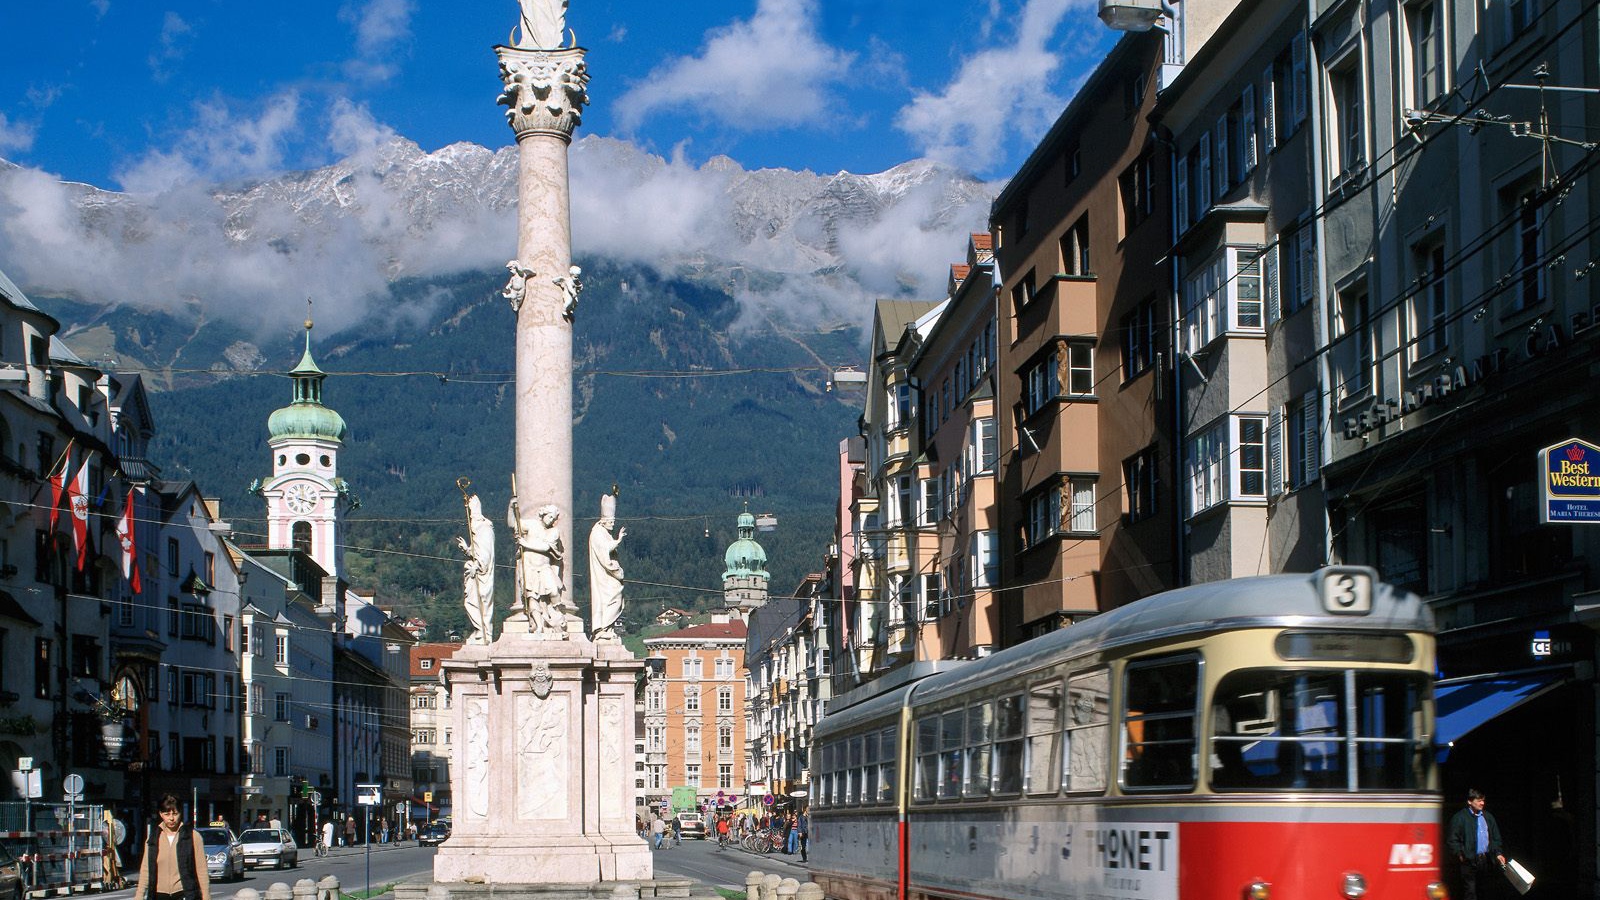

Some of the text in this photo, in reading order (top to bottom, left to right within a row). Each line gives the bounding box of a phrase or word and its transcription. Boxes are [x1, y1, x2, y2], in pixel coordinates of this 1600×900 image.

[1561, 460, 1590, 475] Best
[1550, 472, 1600, 488] Western
[1336, 575, 1356, 608] 3
[1086, 829, 1171, 872] THONET
